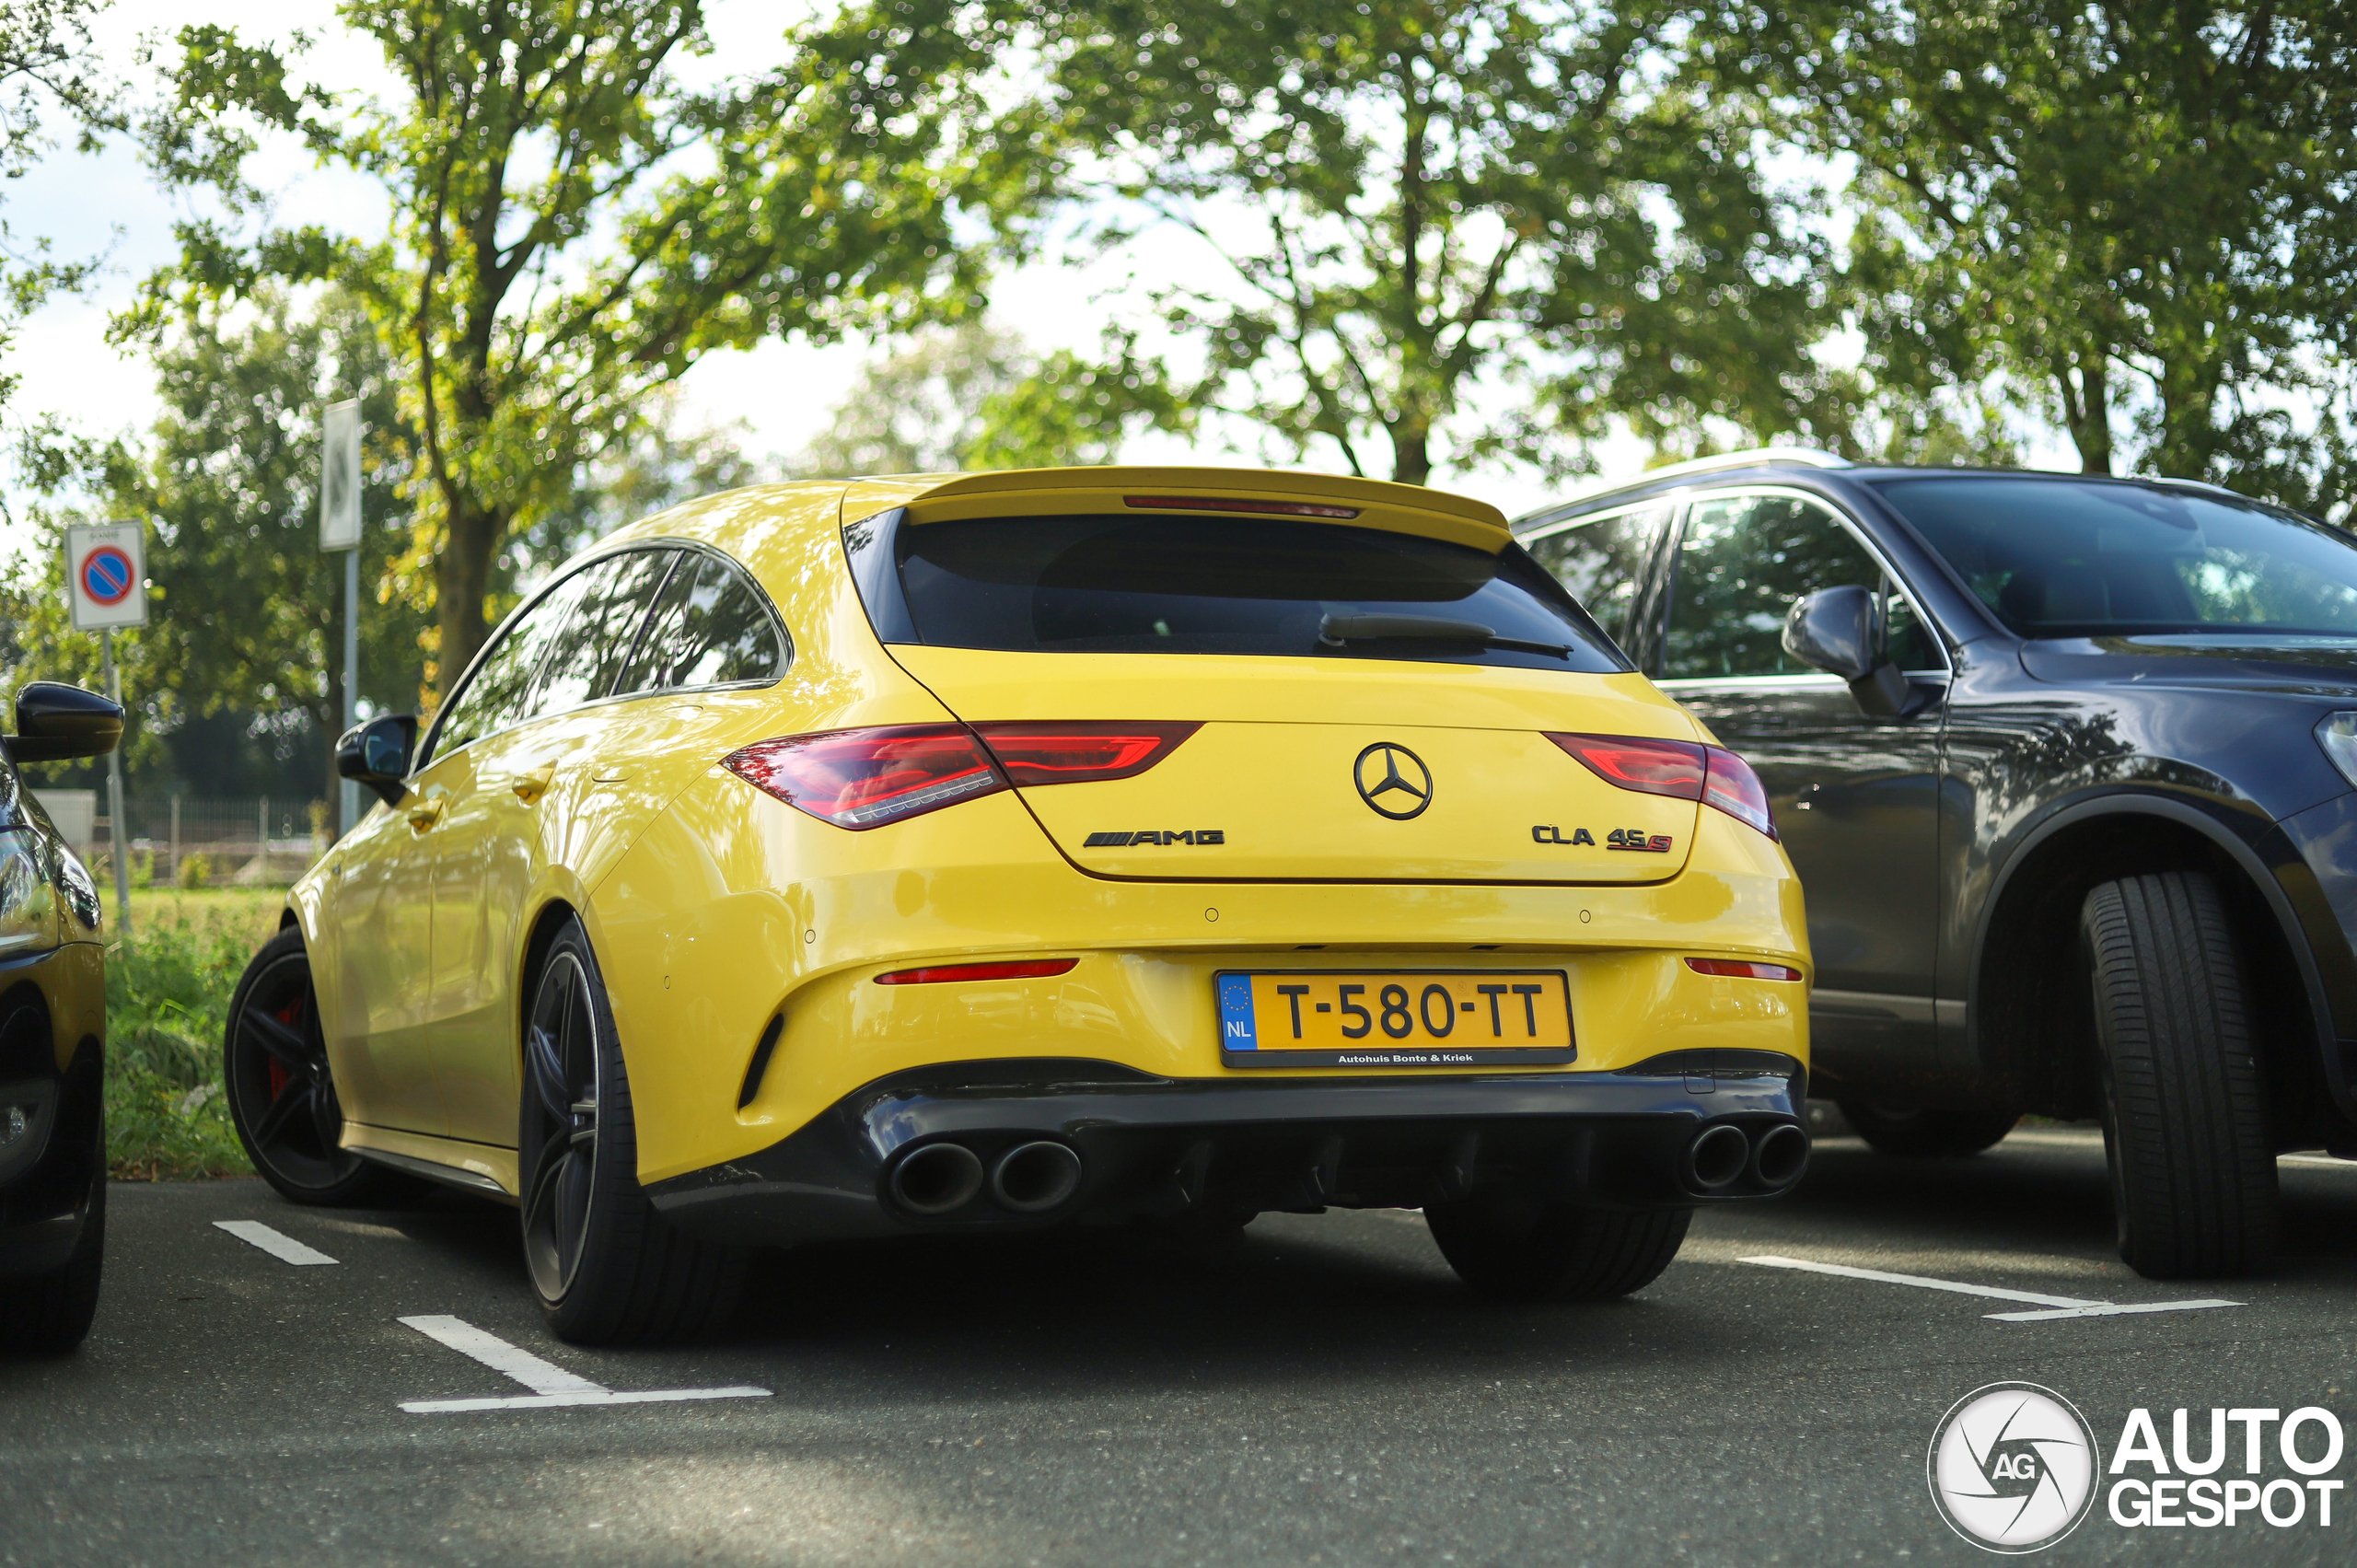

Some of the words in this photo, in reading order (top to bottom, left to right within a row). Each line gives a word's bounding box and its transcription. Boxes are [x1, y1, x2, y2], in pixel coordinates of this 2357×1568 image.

[1129, 830, 1225, 846] AMG
[1532, 825, 1596, 845] CLA
[1277, 983, 1543, 1039] T-580-TT
[1226, 1021, 1251, 1037] NL
[1338, 1054, 1390, 1063] Autohuis
[1393, 1054, 1428, 1063] Bonte
[1430, 1053, 1441, 1063] &
[1443, 1053, 1474, 1062] Kriek
